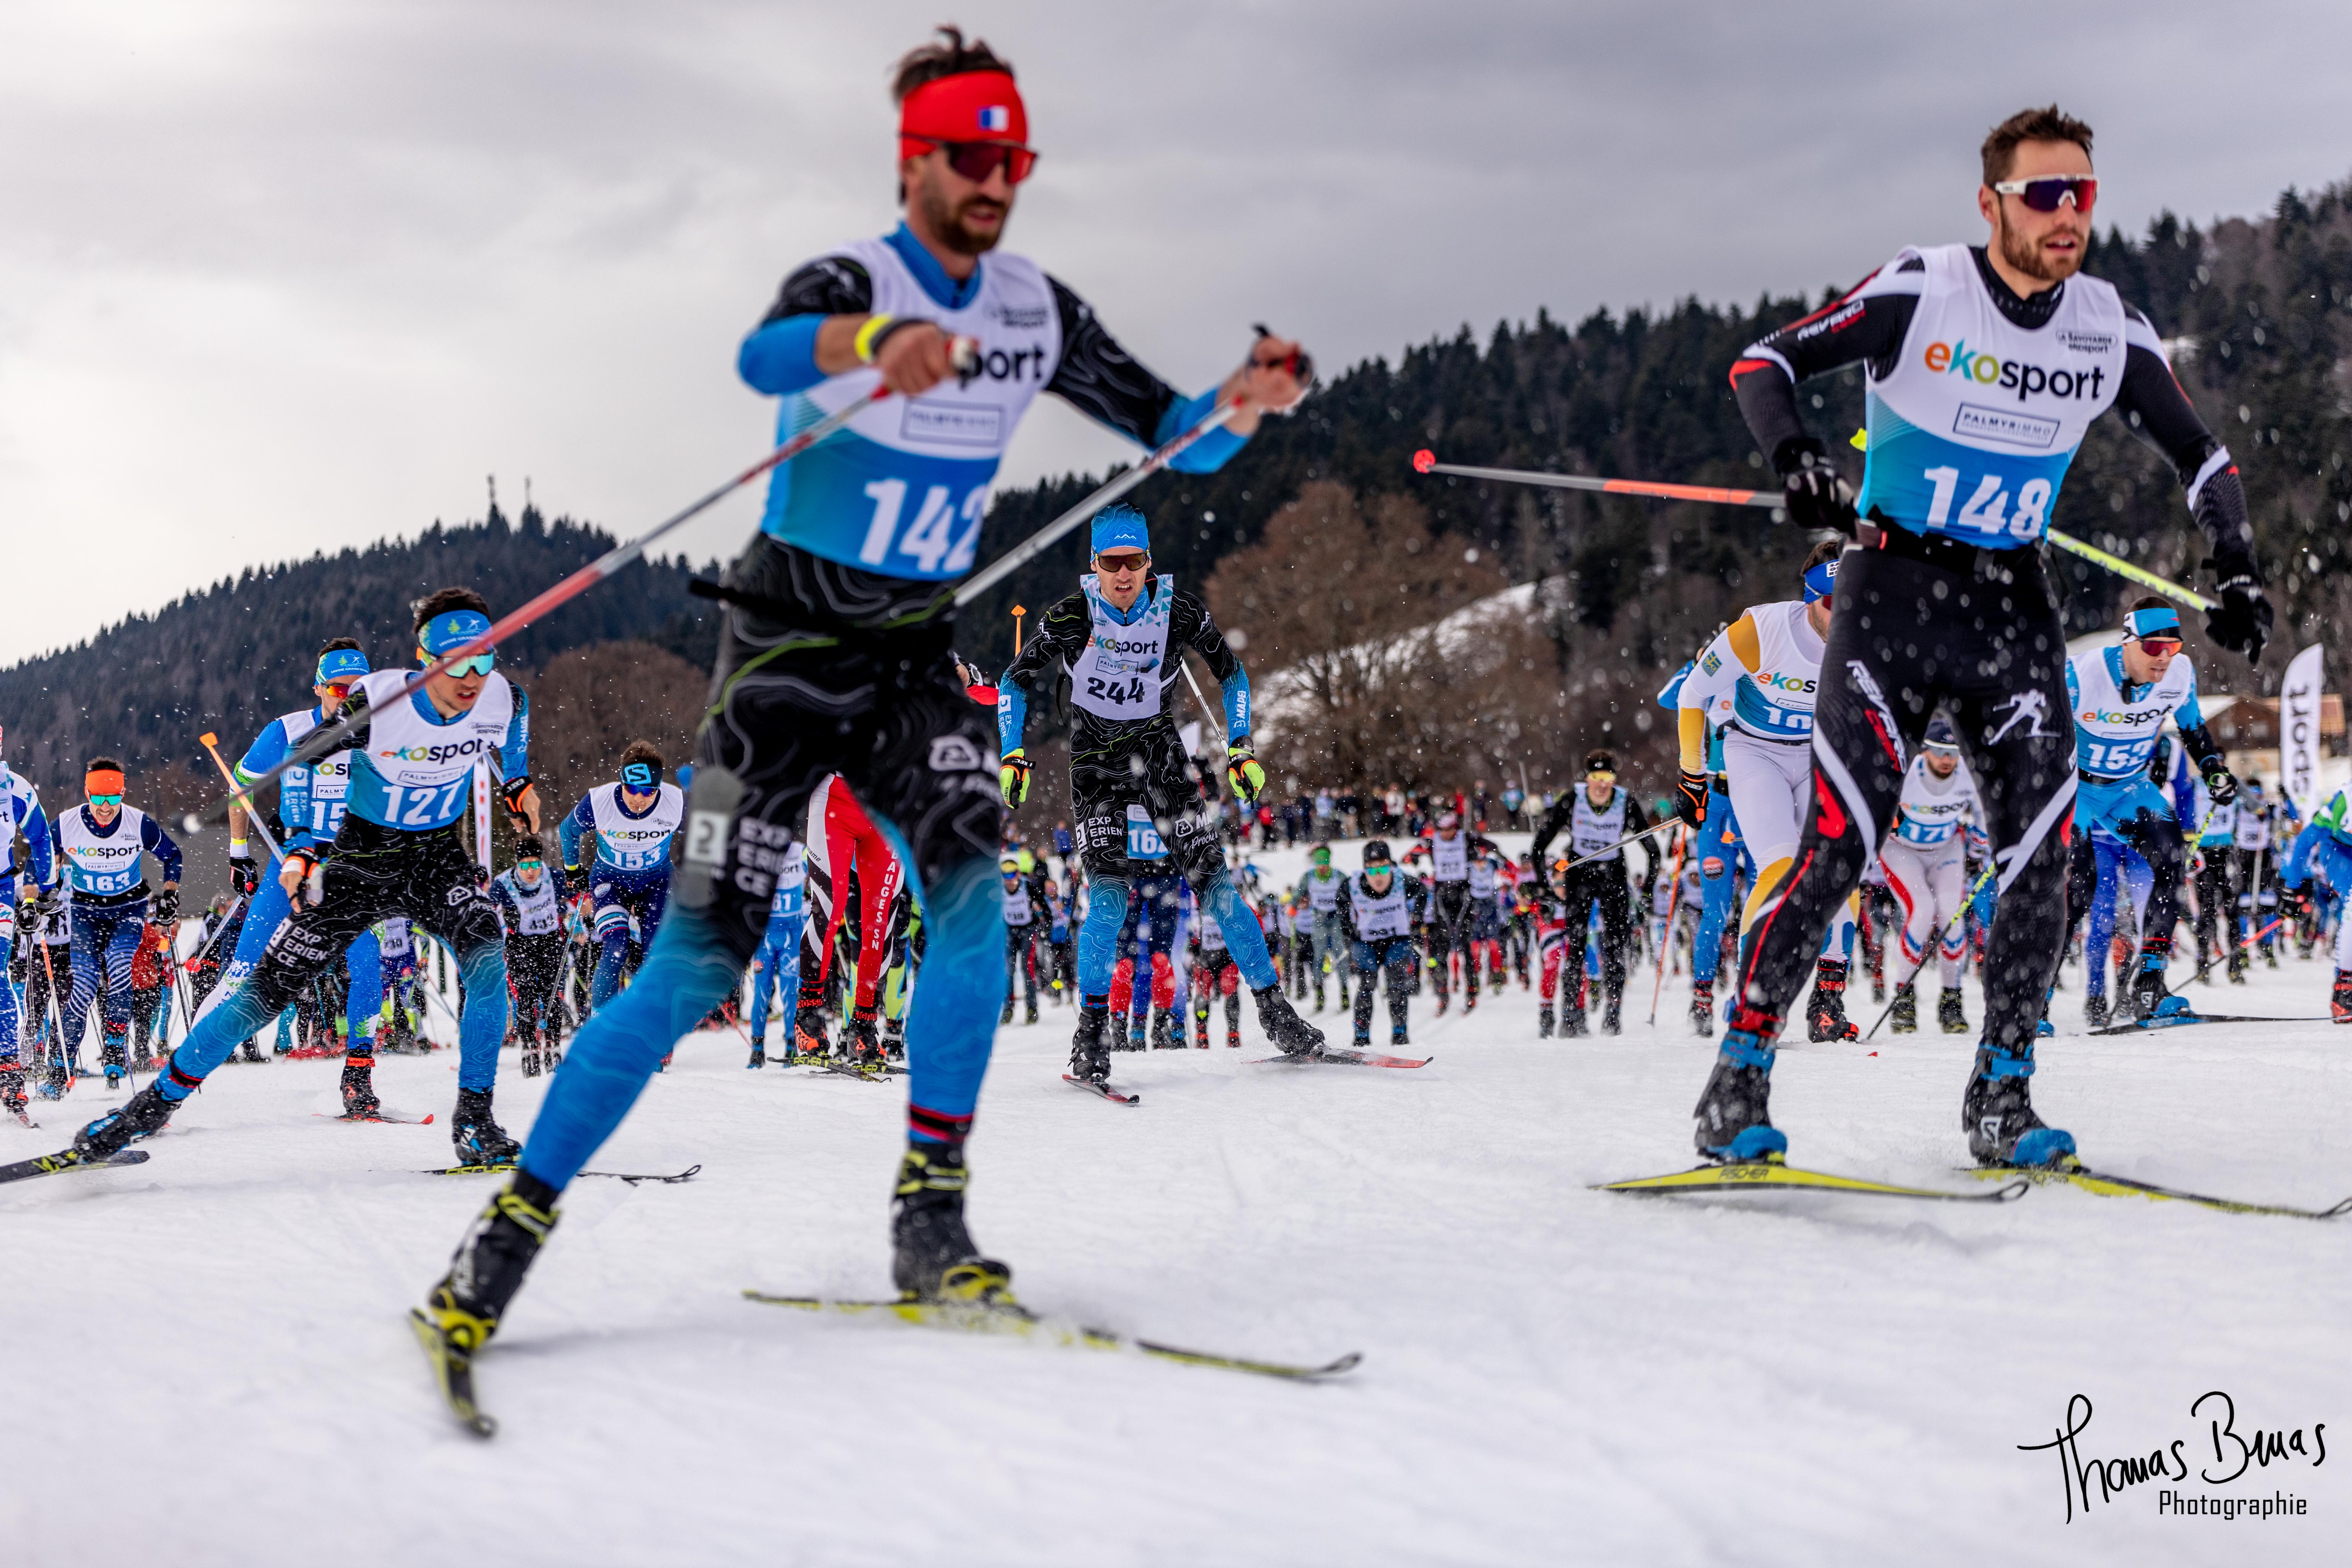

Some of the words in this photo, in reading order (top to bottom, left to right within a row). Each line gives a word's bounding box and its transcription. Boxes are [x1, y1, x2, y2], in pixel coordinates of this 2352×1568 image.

[2068, 332, 2112, 344] SAVOYARDE
[1924, 338, 2104, 402] ekosport
[1963, 412, 2051, 435] PALMYRIMMO
[1924, 466, 2051, 541] 148
[859, 478, 986, 573] 142
[1086, 634, 1158, 657] ekosport
[1087, 677, 1145, 706] 244
[1756, 672, 1817, 693] ekos
[1236, 691, 1246, 718] MAPEI
[2088, 740, 2154, 770] 152
[382, 777, 464, 825] 127
[1088, 816, 1111, 826] EXP
[1090, 826, 1122, 838] ERIEN
[68, 844, 141, 859] ekosport
[1092, 837, 1109, 847] CE
[611, 847, 661, 869] 153
[83, 871, 130, 891] 163
[876, 848, 899, 923] BAUGES
[291, 926, 322, 944] EXP
[872, 929, 880, 951] SN
[277, 951, 298, 968] CE
[283, 938, 328, 960] ERIEN
